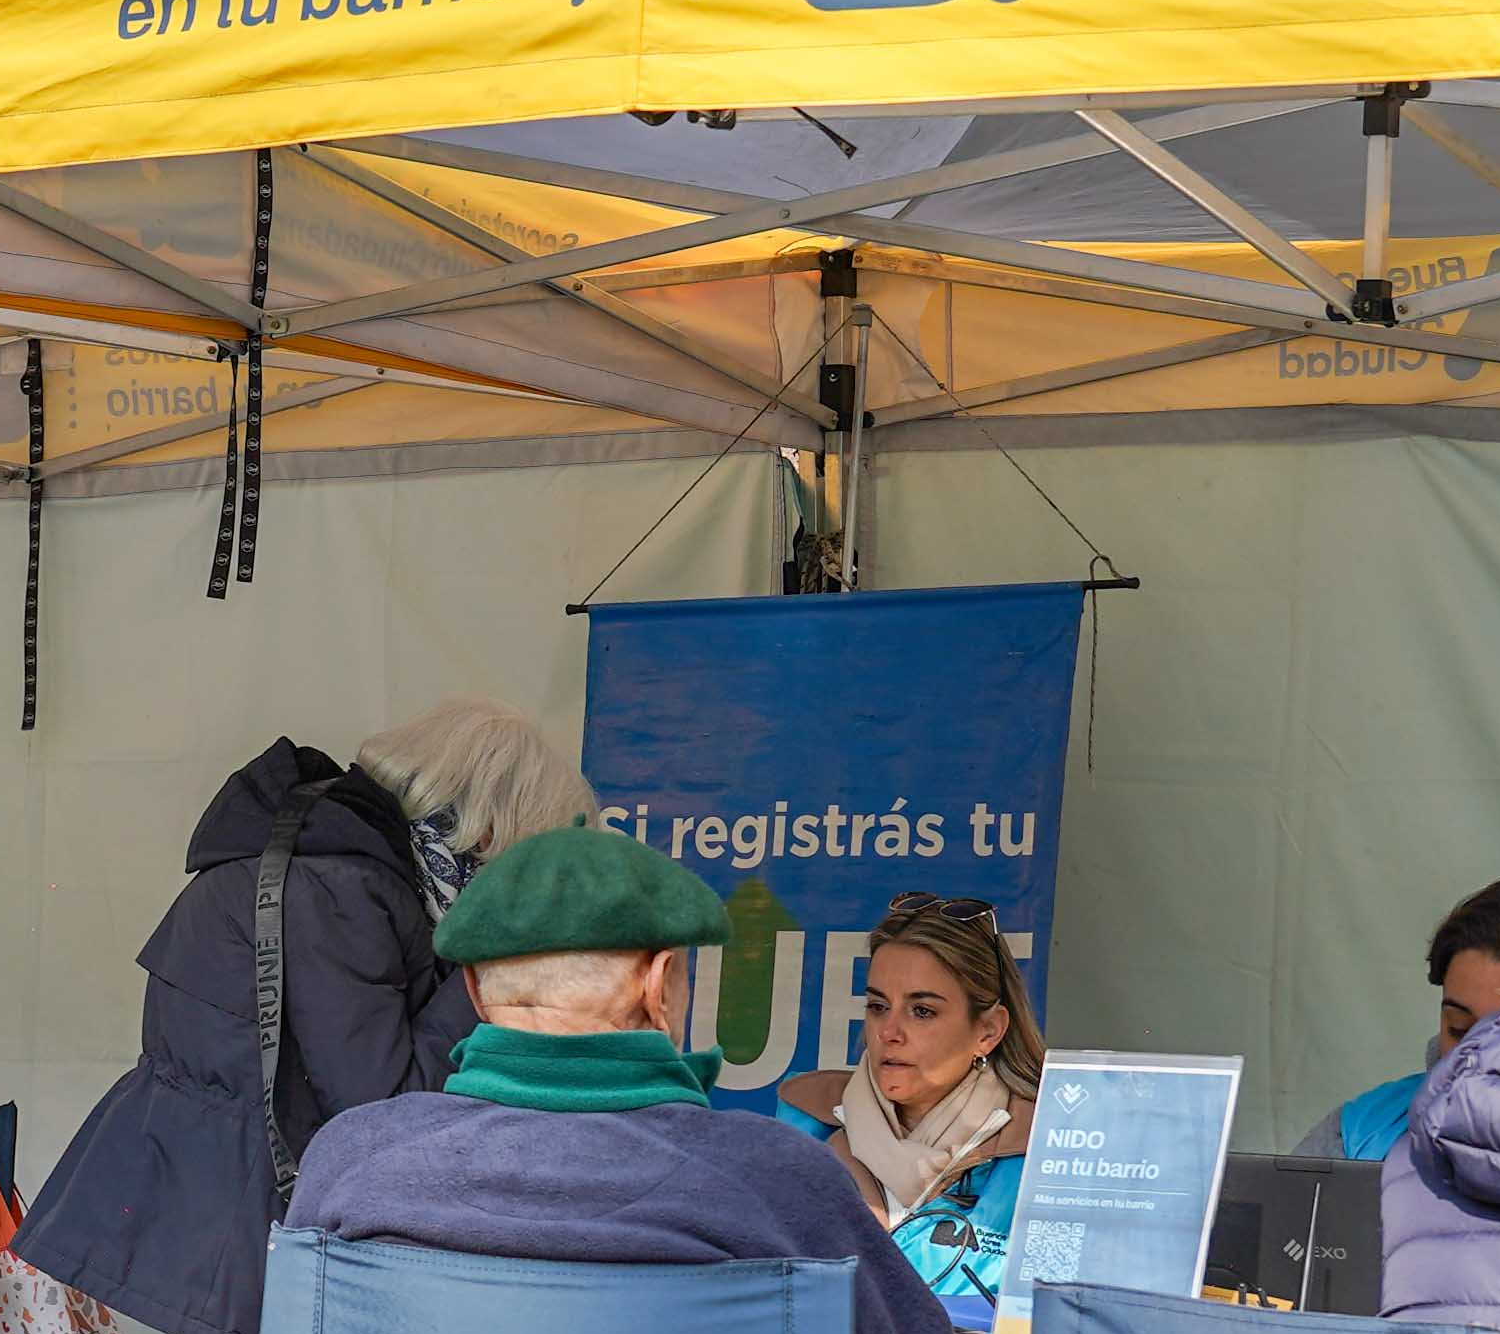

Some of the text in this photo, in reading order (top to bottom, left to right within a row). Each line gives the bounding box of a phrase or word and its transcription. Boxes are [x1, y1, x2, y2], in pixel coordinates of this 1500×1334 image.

[671, 797, 945, 869] registrás
[970, 803, 1035, 857] tu
[257, 937, 280, 1051] PRUNE
[1046, 1129, 1105, 1150] NIDO
[1041, 1158, 1160, 1180] en tu barrio
[1056, 1195, 1099, 1207] servicios
[1100, 1198, 1113, 1208] en
[1114, 1197, 1125, 1209] tu
[1125, 1198, 1155, 1210] barrio
[976, 1228, 1007, 1241] Buenos
